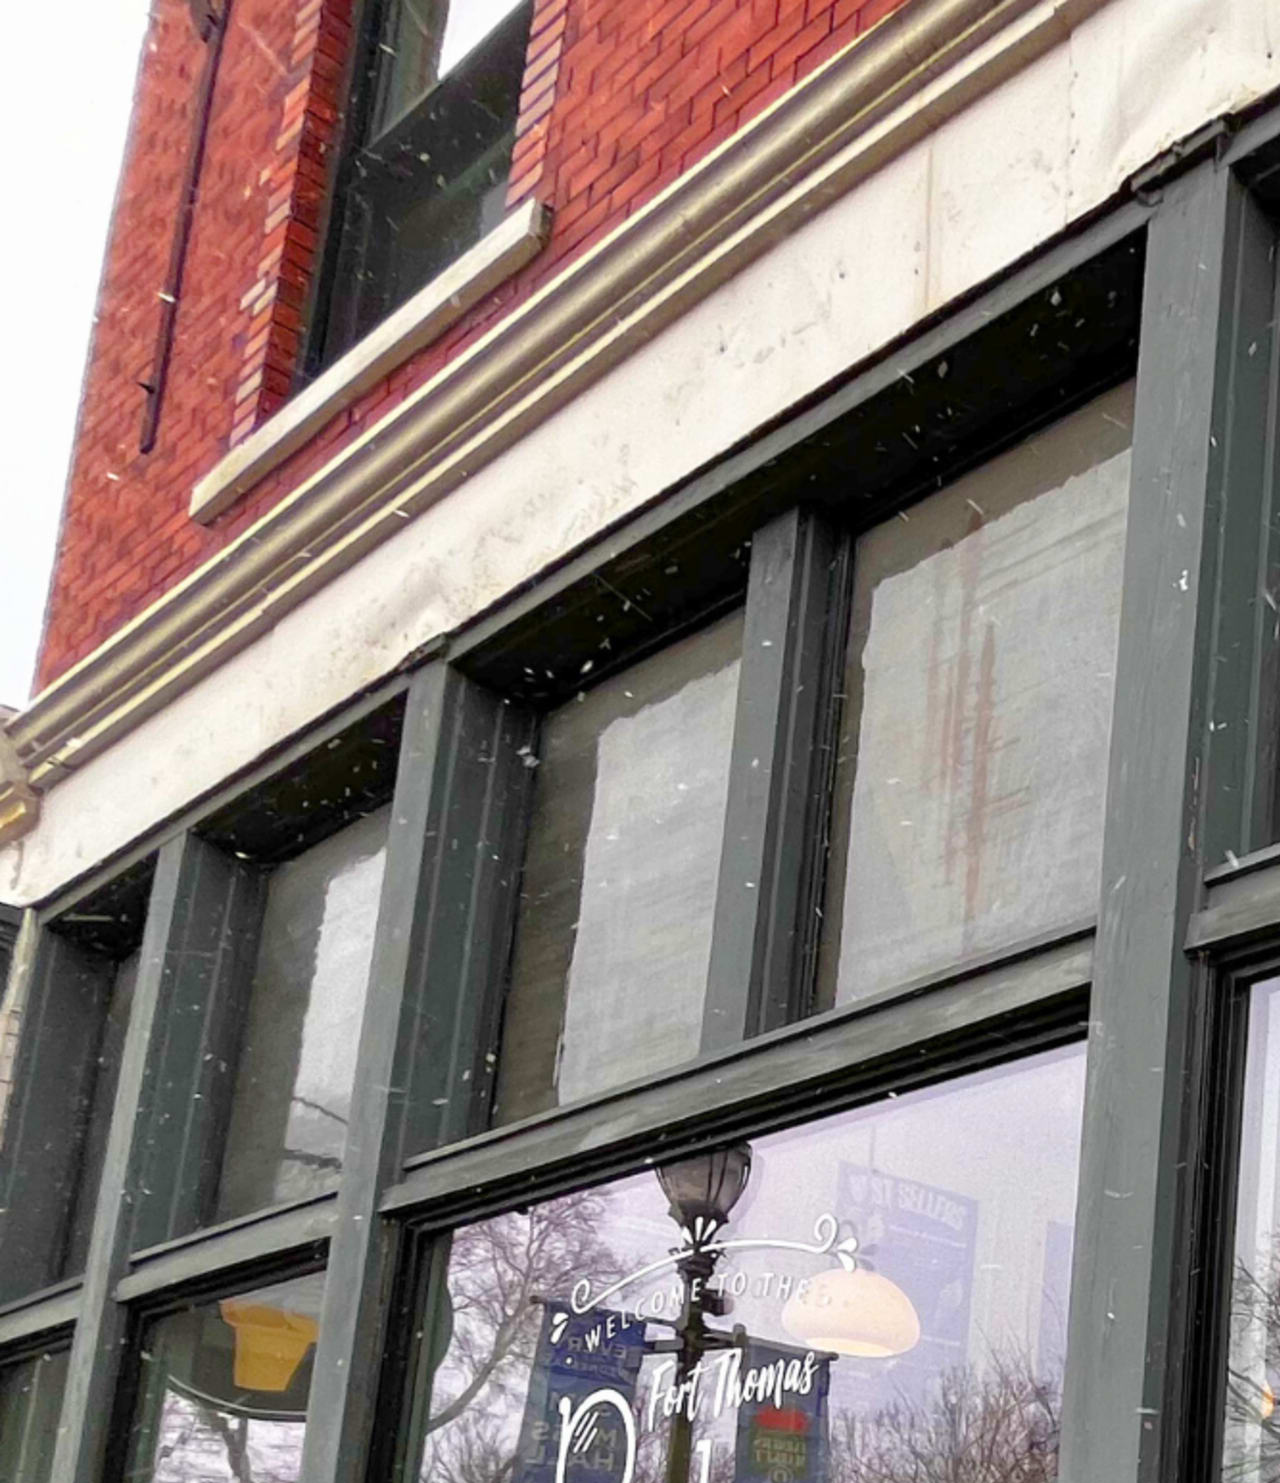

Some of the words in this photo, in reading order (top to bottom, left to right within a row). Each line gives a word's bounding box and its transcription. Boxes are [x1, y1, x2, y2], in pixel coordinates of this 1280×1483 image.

[584, 1277, 702, 1353] WELCOME
[717, 1271, 748, 1298] TO
[648, 1360, 710, 1433] Fort
[706, 1347, 820, 1418] Thomas
